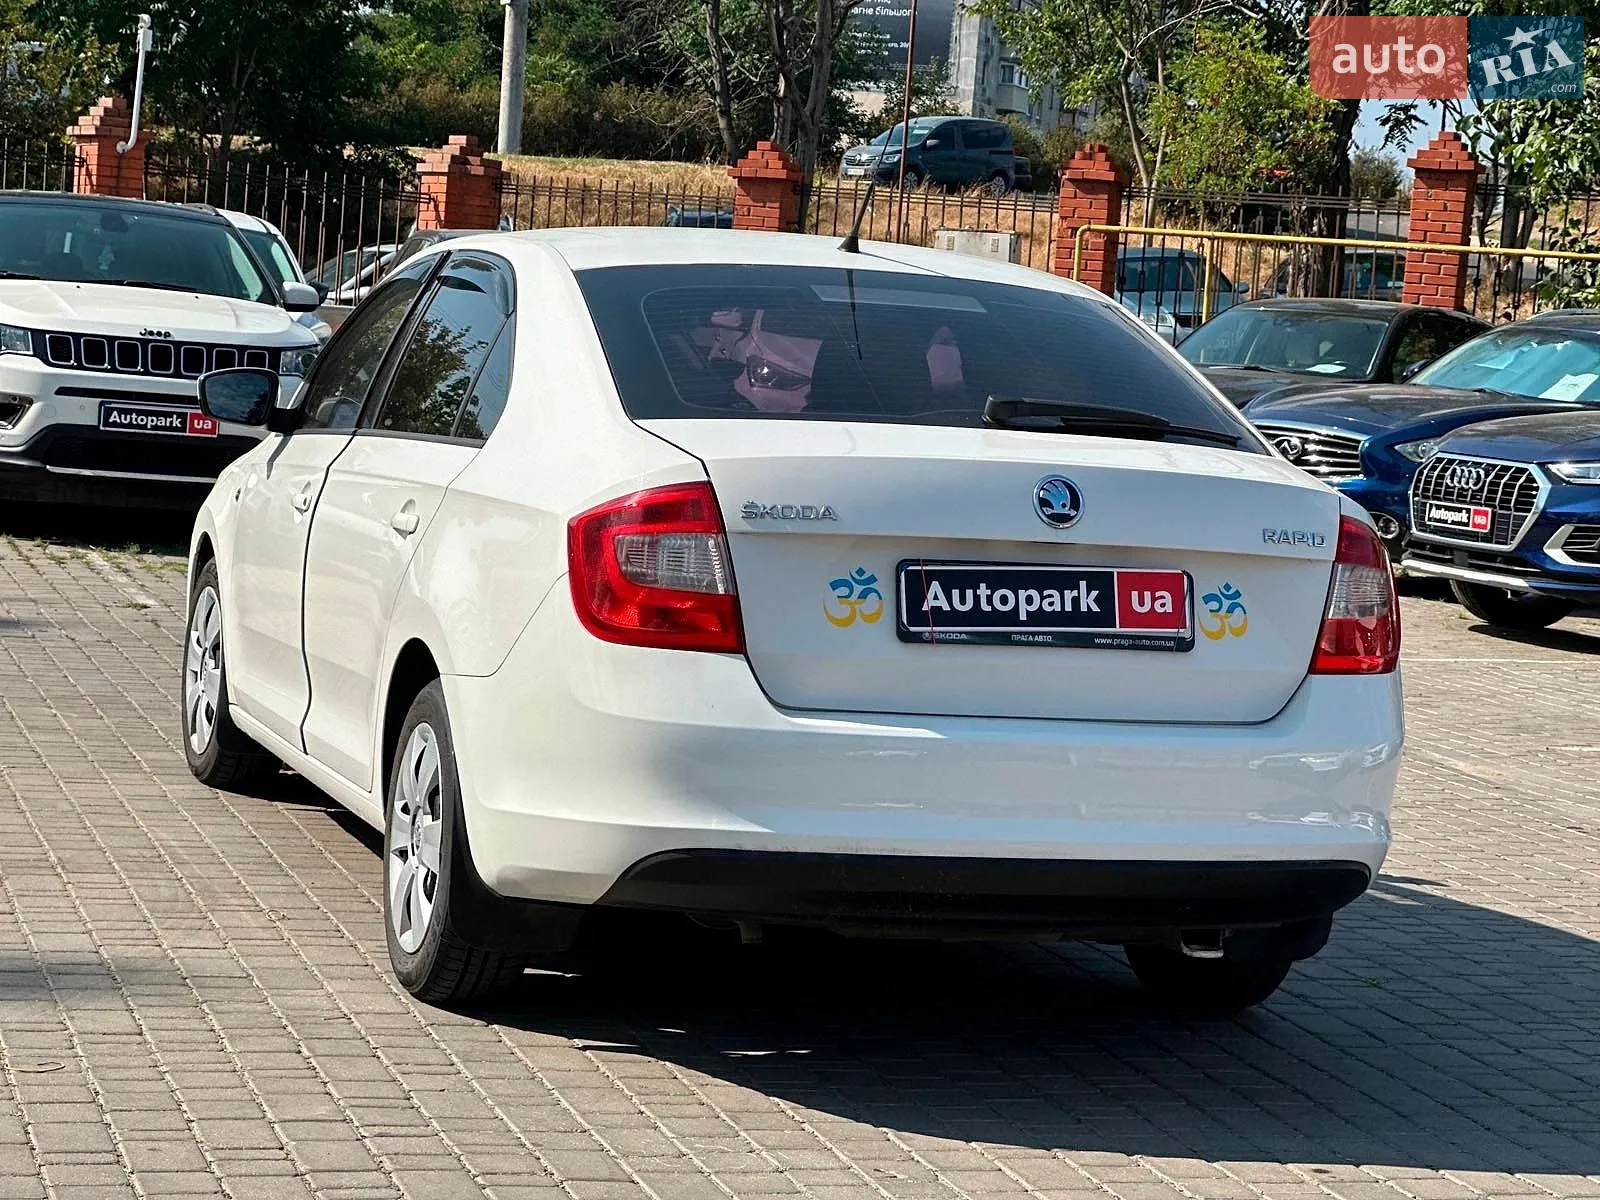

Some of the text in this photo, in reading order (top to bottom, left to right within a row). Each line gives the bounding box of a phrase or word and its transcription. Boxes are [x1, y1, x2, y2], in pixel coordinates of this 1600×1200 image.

[138, 327, 172, 339] Jeep
[109, 410, 212, 429] Autopark ua
[739, 500, 838, 521] ŠKODA
[1429, 506, 1487, 525] Autopark ua
[1262, 528, 1327, 548] RAPID
[922, 580, 1174, 620] Autopark ua
